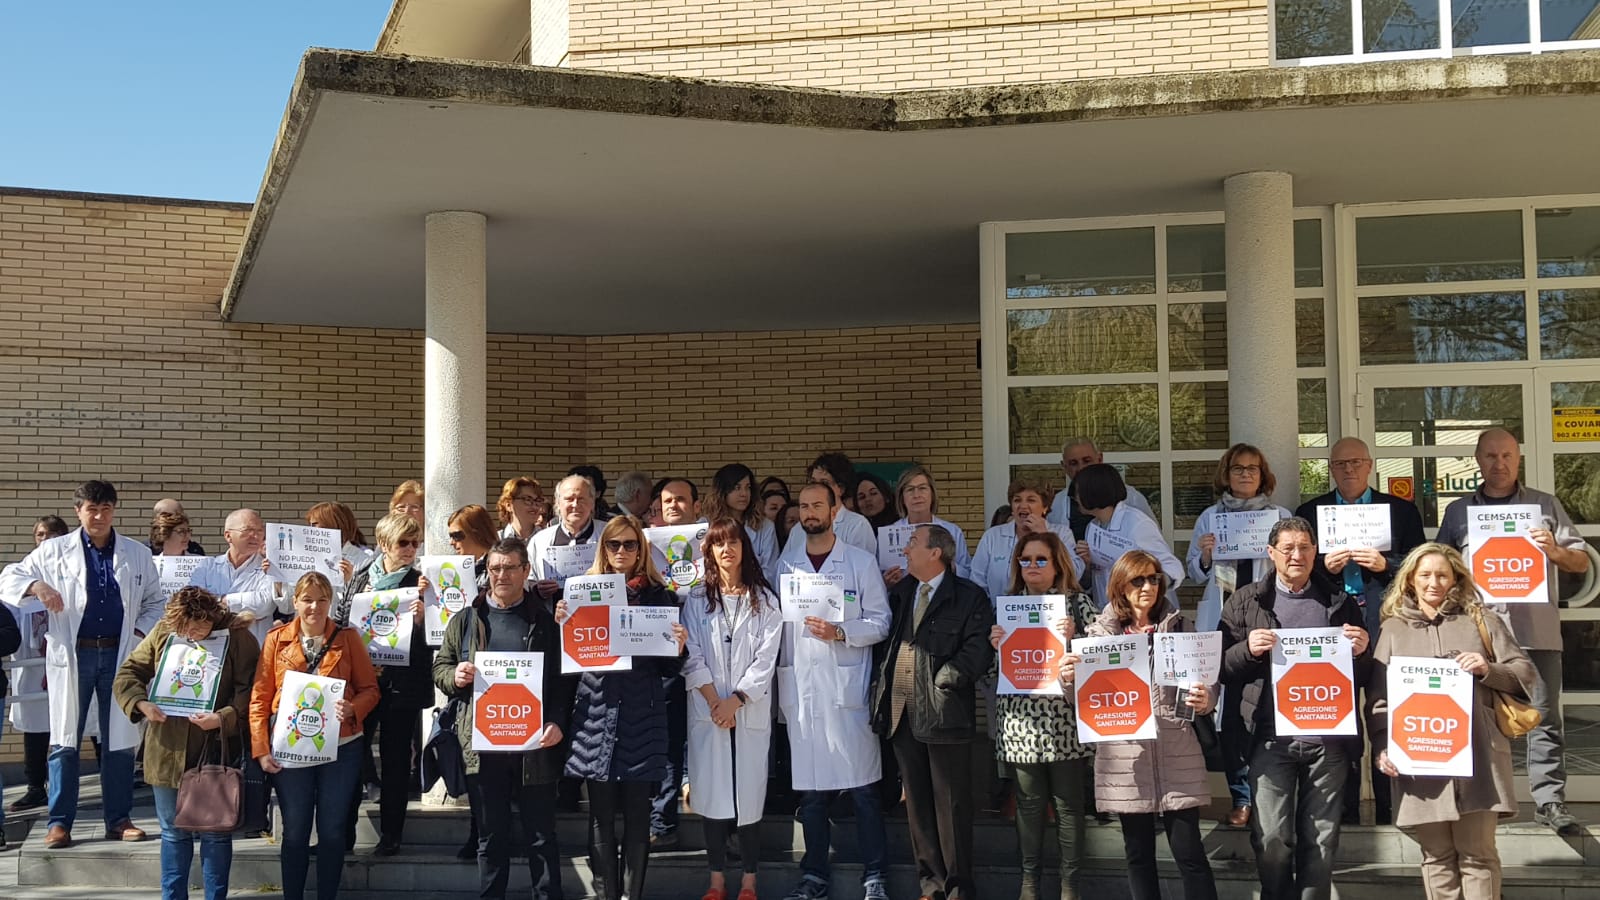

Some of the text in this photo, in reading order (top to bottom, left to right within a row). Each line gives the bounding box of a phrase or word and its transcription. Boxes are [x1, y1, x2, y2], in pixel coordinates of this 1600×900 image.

[1424, 473, 1478, 490] salud
[1477, 512, 1532, 521] CEMSATSE
[306, 536, 330, 546] SIENTO
[304, 544, 331, 554] SEGURO
[279, 562, 316, 571] TRABAJAR
[674, 566, 692, 574] STOP
[1483, 558, 1534, 573] STOP
[570, 582, 615, 591] CEMSATSE
[1005, 603, 1054, 612] CEMSATSE
[376, 615, 394, 624] STOP
[573, 626, 608, 642] STO
[1281, 636, 1338, 646] CEMSATSE
[1082, 642, 1137, 654] CEMSATSE
[1011, 650, 1055, 664] STOP
[483, 660, 532, 668] CEMSATSE
[1164, 670, 1188, 678] salud
[1400, 666, 1460, 676] CEMSATSE
[1288, 686, 1341, 702] STOP
[1090, 692, 1139, 709] STOP
[486, 704, 532, 718] STOP
[1094, 712, 1136, 720] AGRESIONES
[301, 714, 319, 724] STOP
[1096, 719, 1136, 727] SANITARIAS
[1403, 716, 1458, 734] STOP
[1407, 737, 1454, 746] AGRESIONES
[1408, 744, 1452, 754] SANITARIAS
[274, 751, 302, 760] RESPETO
